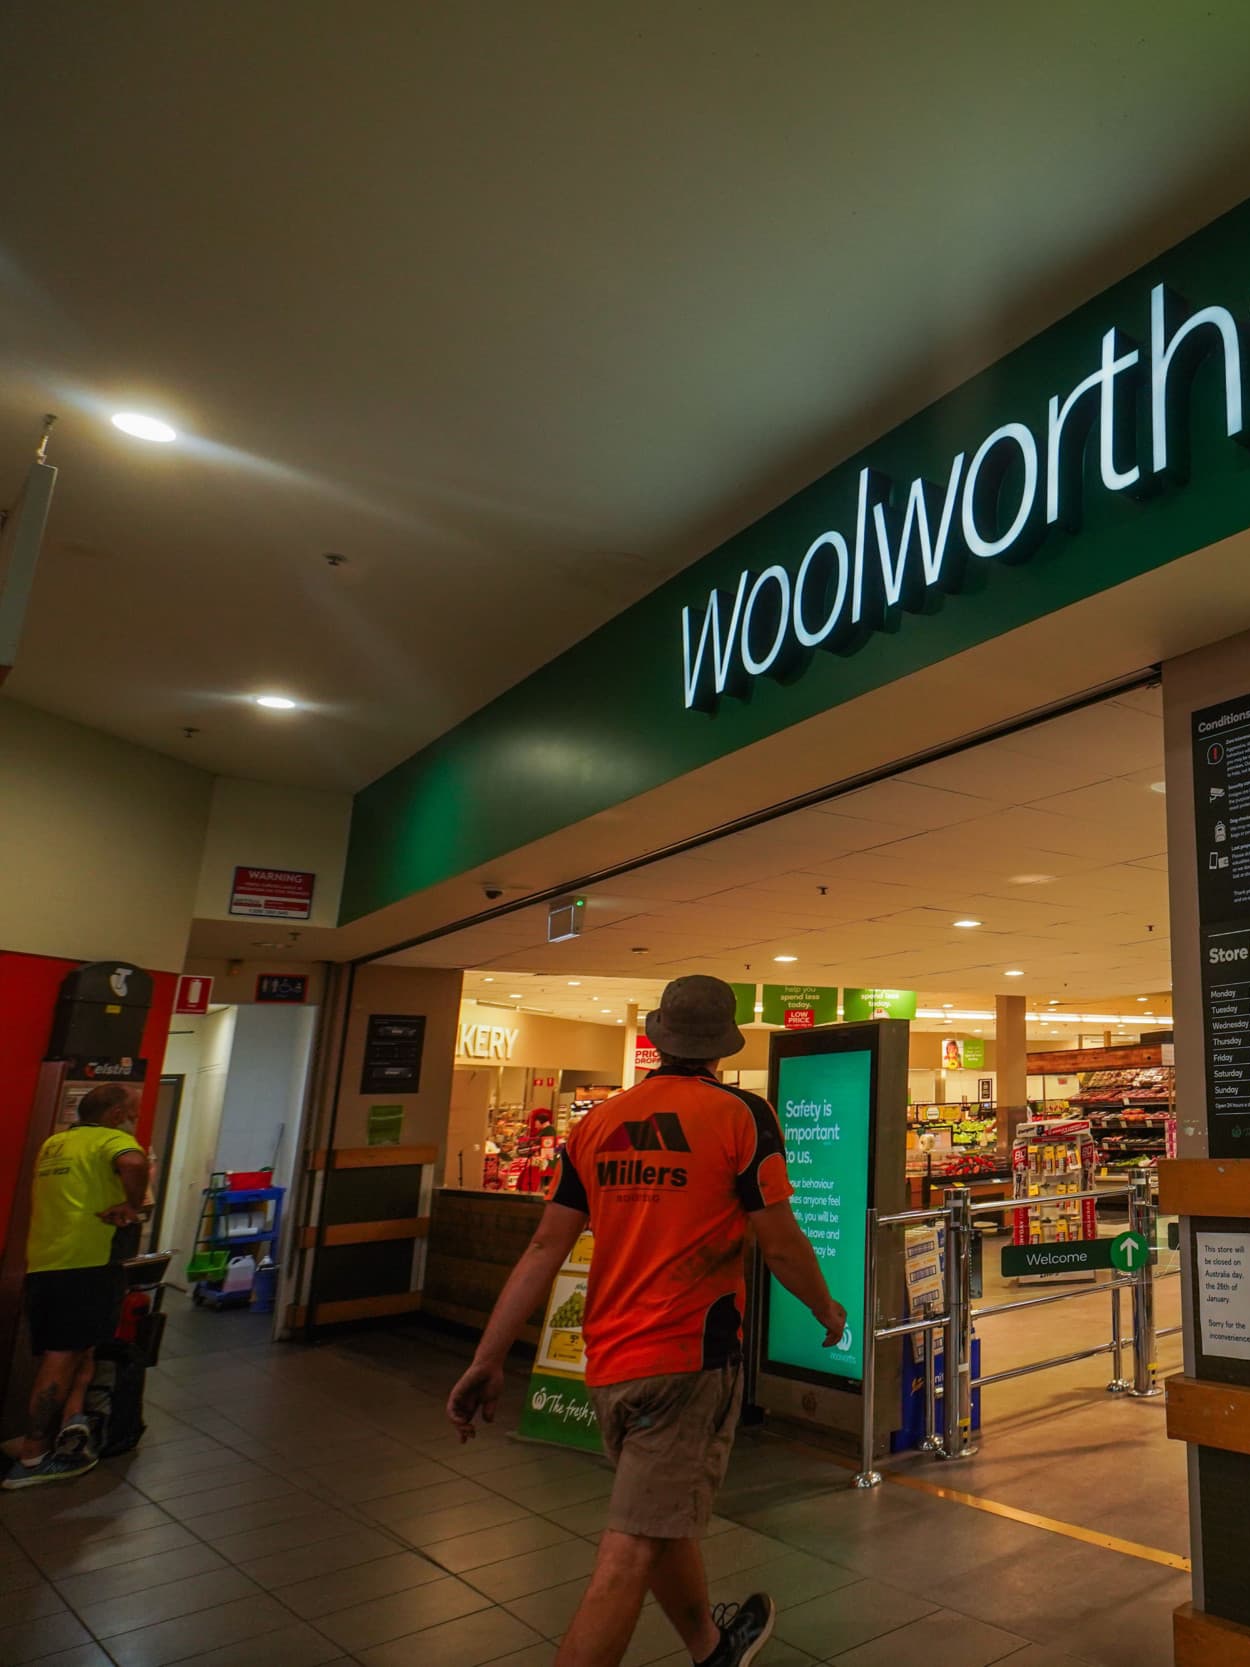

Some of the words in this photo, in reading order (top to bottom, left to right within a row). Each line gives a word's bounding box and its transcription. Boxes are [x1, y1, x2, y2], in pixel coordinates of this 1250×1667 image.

[248, 870, 303, 883] WARNING
[1209, 947, 1248, 964] Store
[780, 994, 804, 1002] spend
[1210, 989, 1236, 999] Monday
[1212, 1005, 1238, 1014] Tuesday
[1212, 1020, 1249, 1030] Wednesday
[456, 1024, 519, 1060] KERY
[1214, 1036, 1242, 1046] Thursday
[635, 1050, 660, 1058] PRIC
[1213, 1054, 1233, 1063] Friday
[1214, 1069, 1244, 1078] Saturday
[1214, 1086, 1239, 1095] Sunday
[786, 1099, 822, 1122] Safety
[824, 1099, 832, 1117] is
[784, 1123, 840, 1145] important
[785, 1148, 796, 1164] to
[798, 1151, 813, 1164] us.
[596, 1159, 688, 1188] Millers
[802, 1178, 834, 1189] behaviour
[803, 1197, 827, 1208] anyone
[828, 1195, 840, 1206] feel
[804, 1212, 816, 1224] you
[818, 1211, 828, 1222] will
[830, 1212, 838, 1223] be
[808, 1227, 825, 1238] leave
[826, 1228, 840, 1240] and
[827, 1245, 836, 1256] be
[1204, 1244, 1216, 1254] This
[1218, 1246, 1233, 1254] store
[1234, 1245, 1245, 1254] will
[1026, 1252, 1088, 1266] Welcome
[1213, 1258, 1232, 1266] closed
[1205, 1270, 1230, 1278] Australia
[1206, 1282, 1216, 1290] the
[1208, 1319, 1224, 1329] Sorry
[1225, 1320, 1234, 1329] for
[1235, 1322, 1246, 1330] the
[547, 1394, 565, 1414] The
[563, 1398, 589, 1423] fresh
